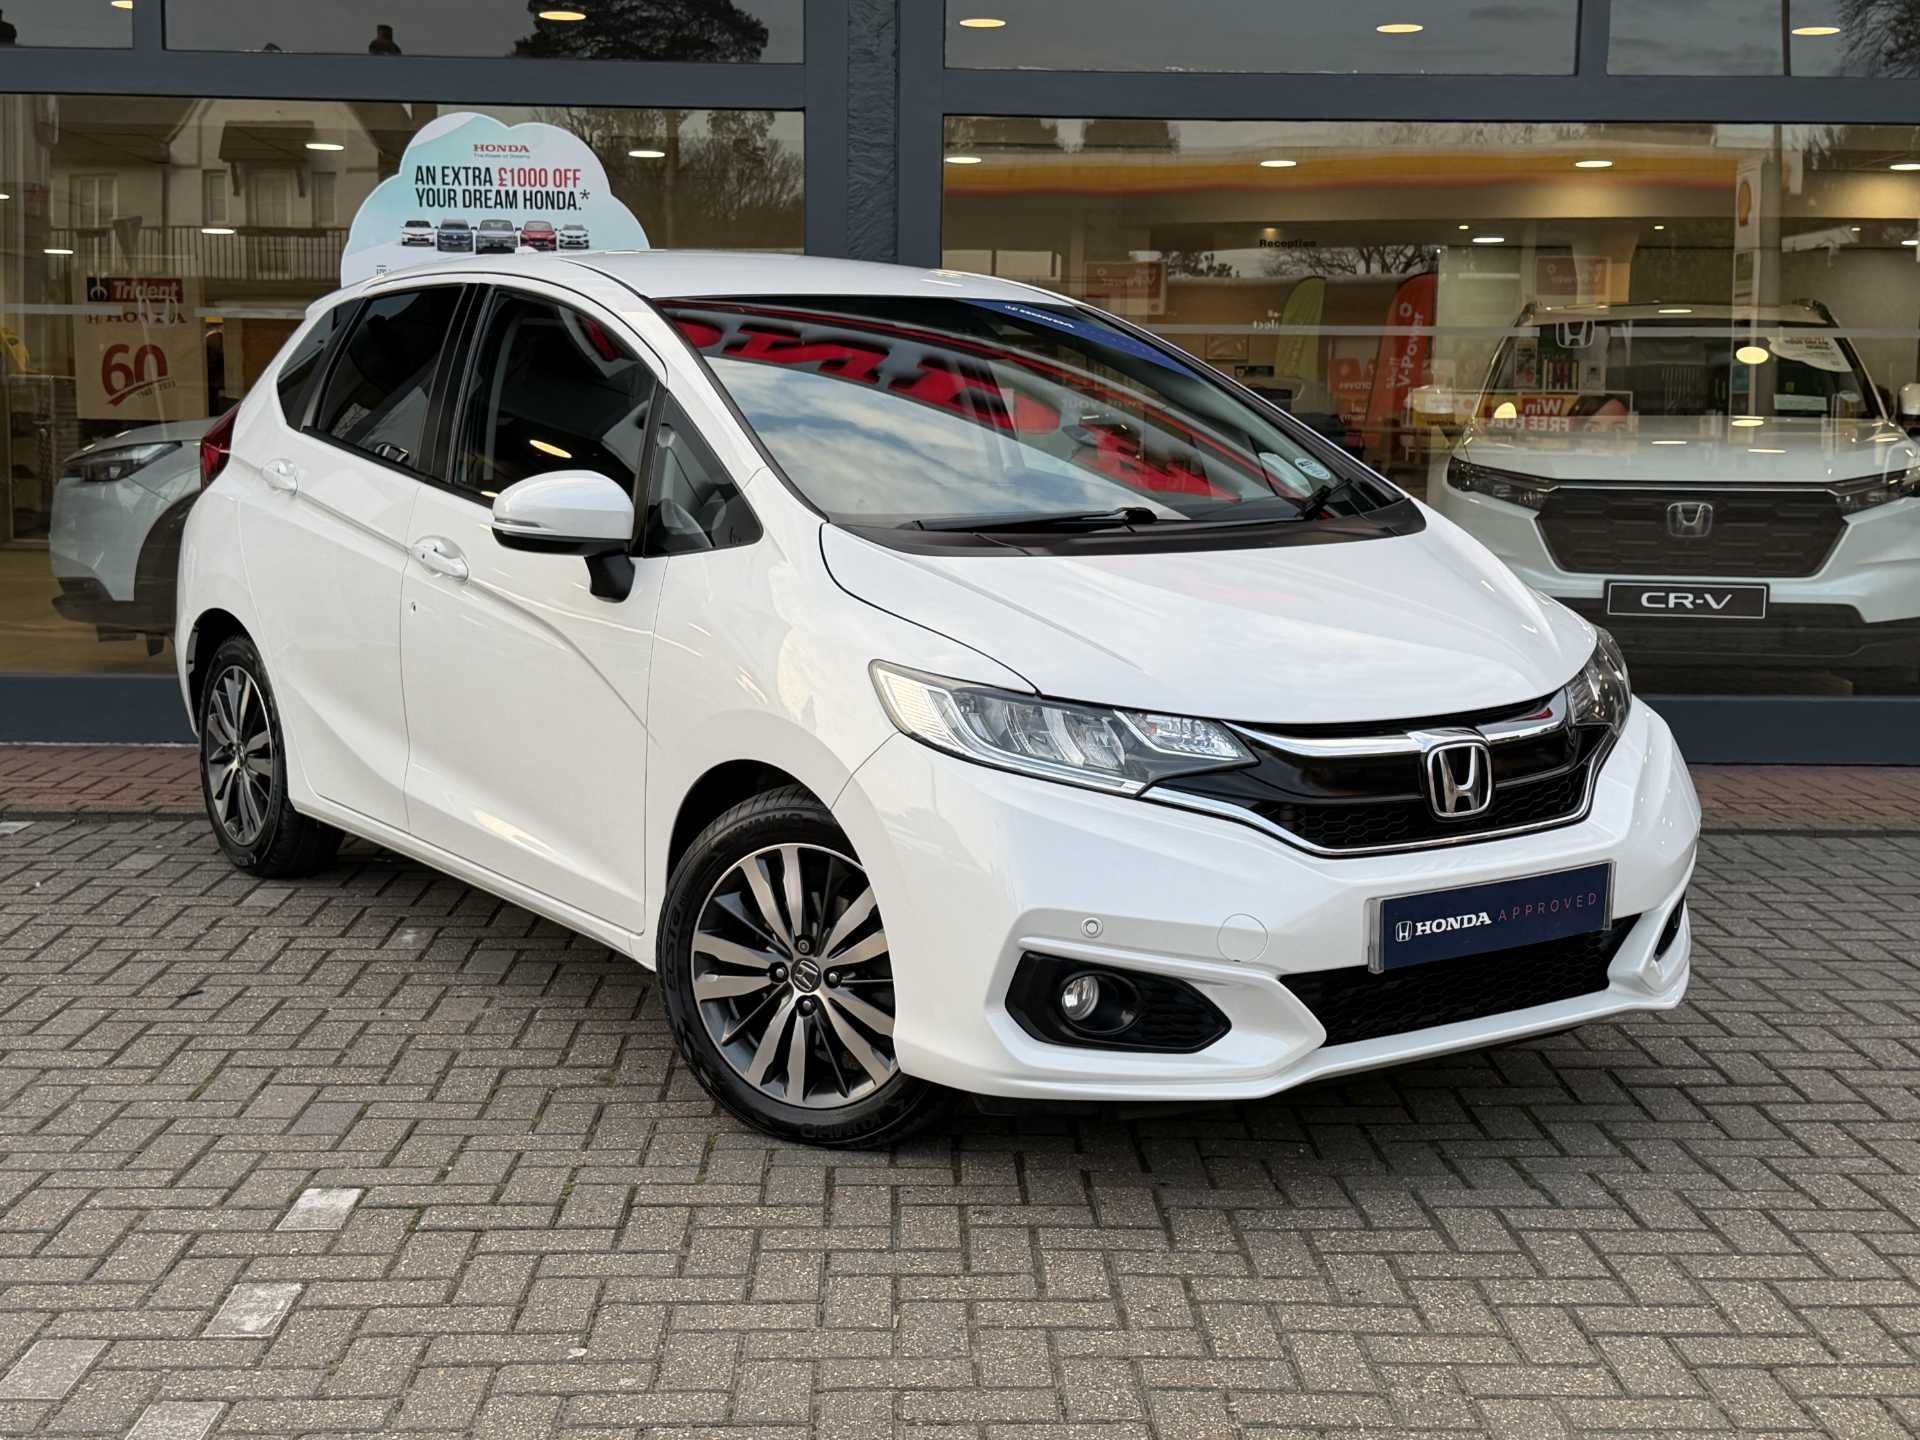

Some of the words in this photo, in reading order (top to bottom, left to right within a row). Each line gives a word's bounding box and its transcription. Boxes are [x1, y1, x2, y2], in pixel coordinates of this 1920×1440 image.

[473, 144, 530, 153] HONDA
[415, 166, 436, 187] AN
[442, 166, 493, 187] EXTRA
[498, 167, 548, 188] £1000
[553, 168, 582, 188] OFF
[416, 188, 458, 209] YOUR
[462, 189, 518, 210] DREAM
[1259, 239, 1317, 249] Reception
[114, 281, 177, 300] Trident
[102, 344, 168, 397] 60
[1640, 592, 1733, 610] CR-V
[1415, 911, 1493, 936] HONDA
[1498, 892, 1598, 922] APPROVED
